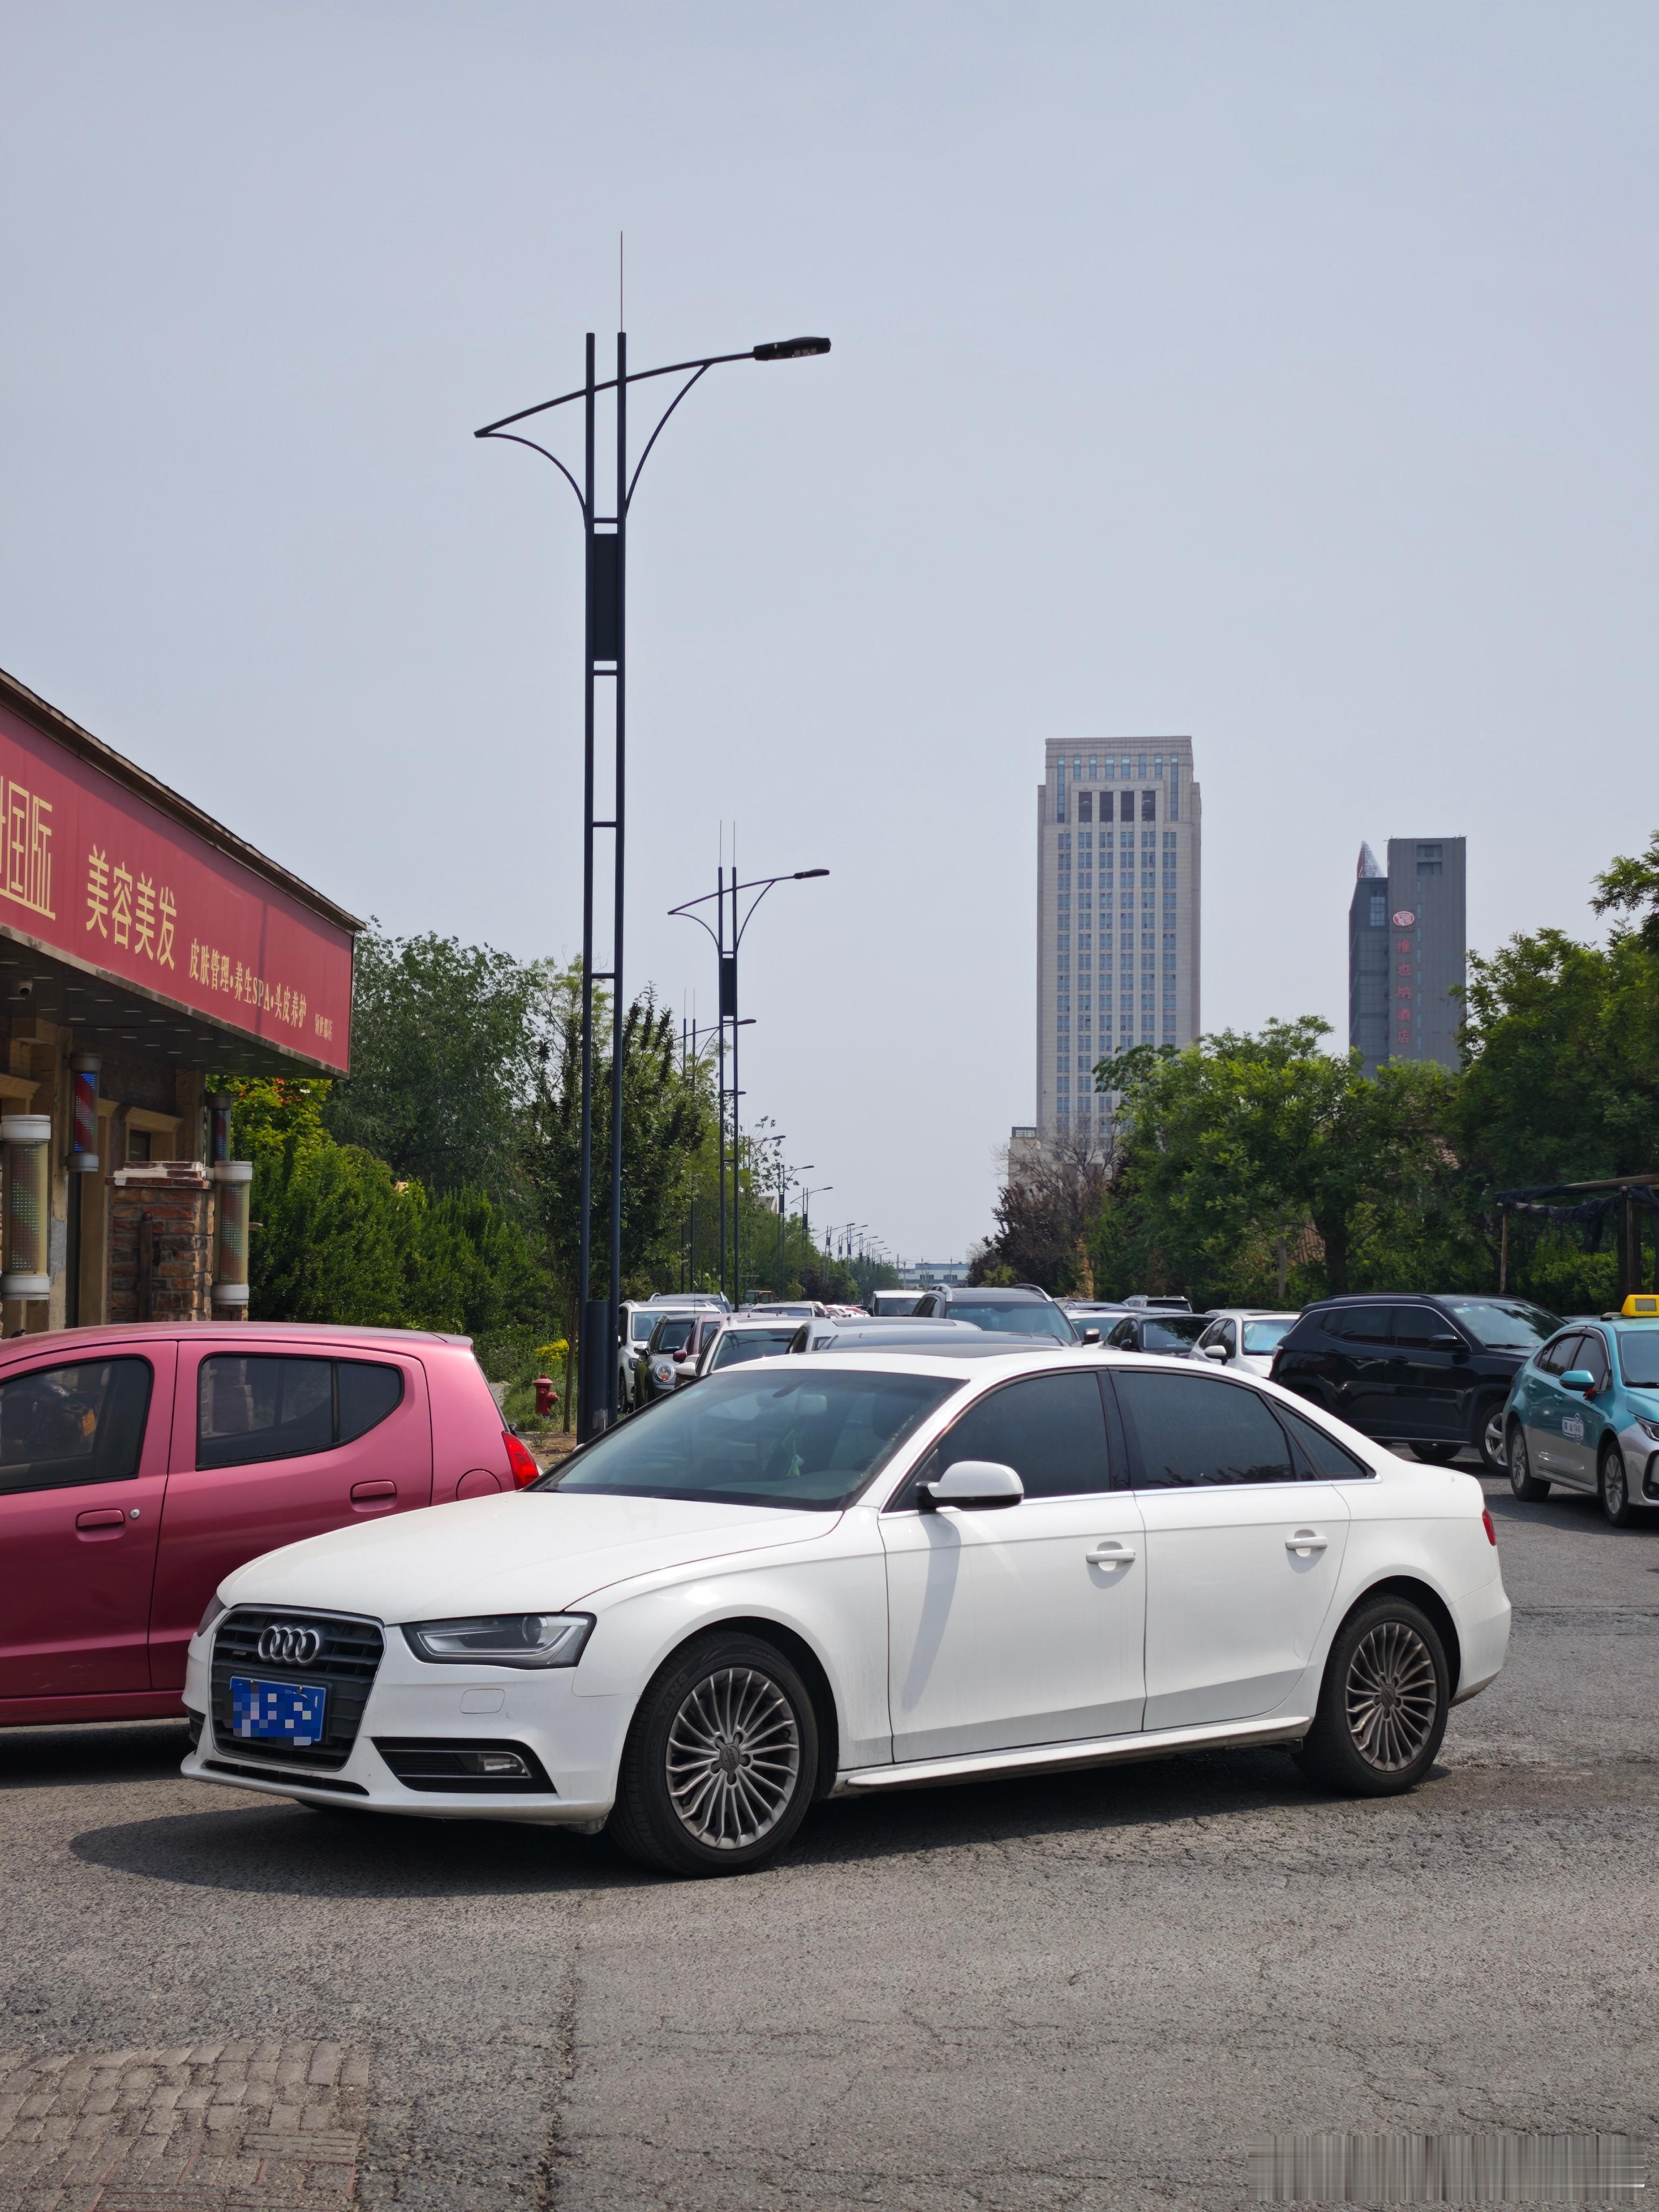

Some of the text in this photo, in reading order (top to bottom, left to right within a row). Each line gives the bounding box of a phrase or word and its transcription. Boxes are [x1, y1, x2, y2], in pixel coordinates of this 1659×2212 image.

[0, 775, 56, 921] 国际
[86, 844, 177, 970] 美容美发
[1396, 938, 1412, 1044] 维也纳酒店
[657, 1673, 687, 1718] YANG
